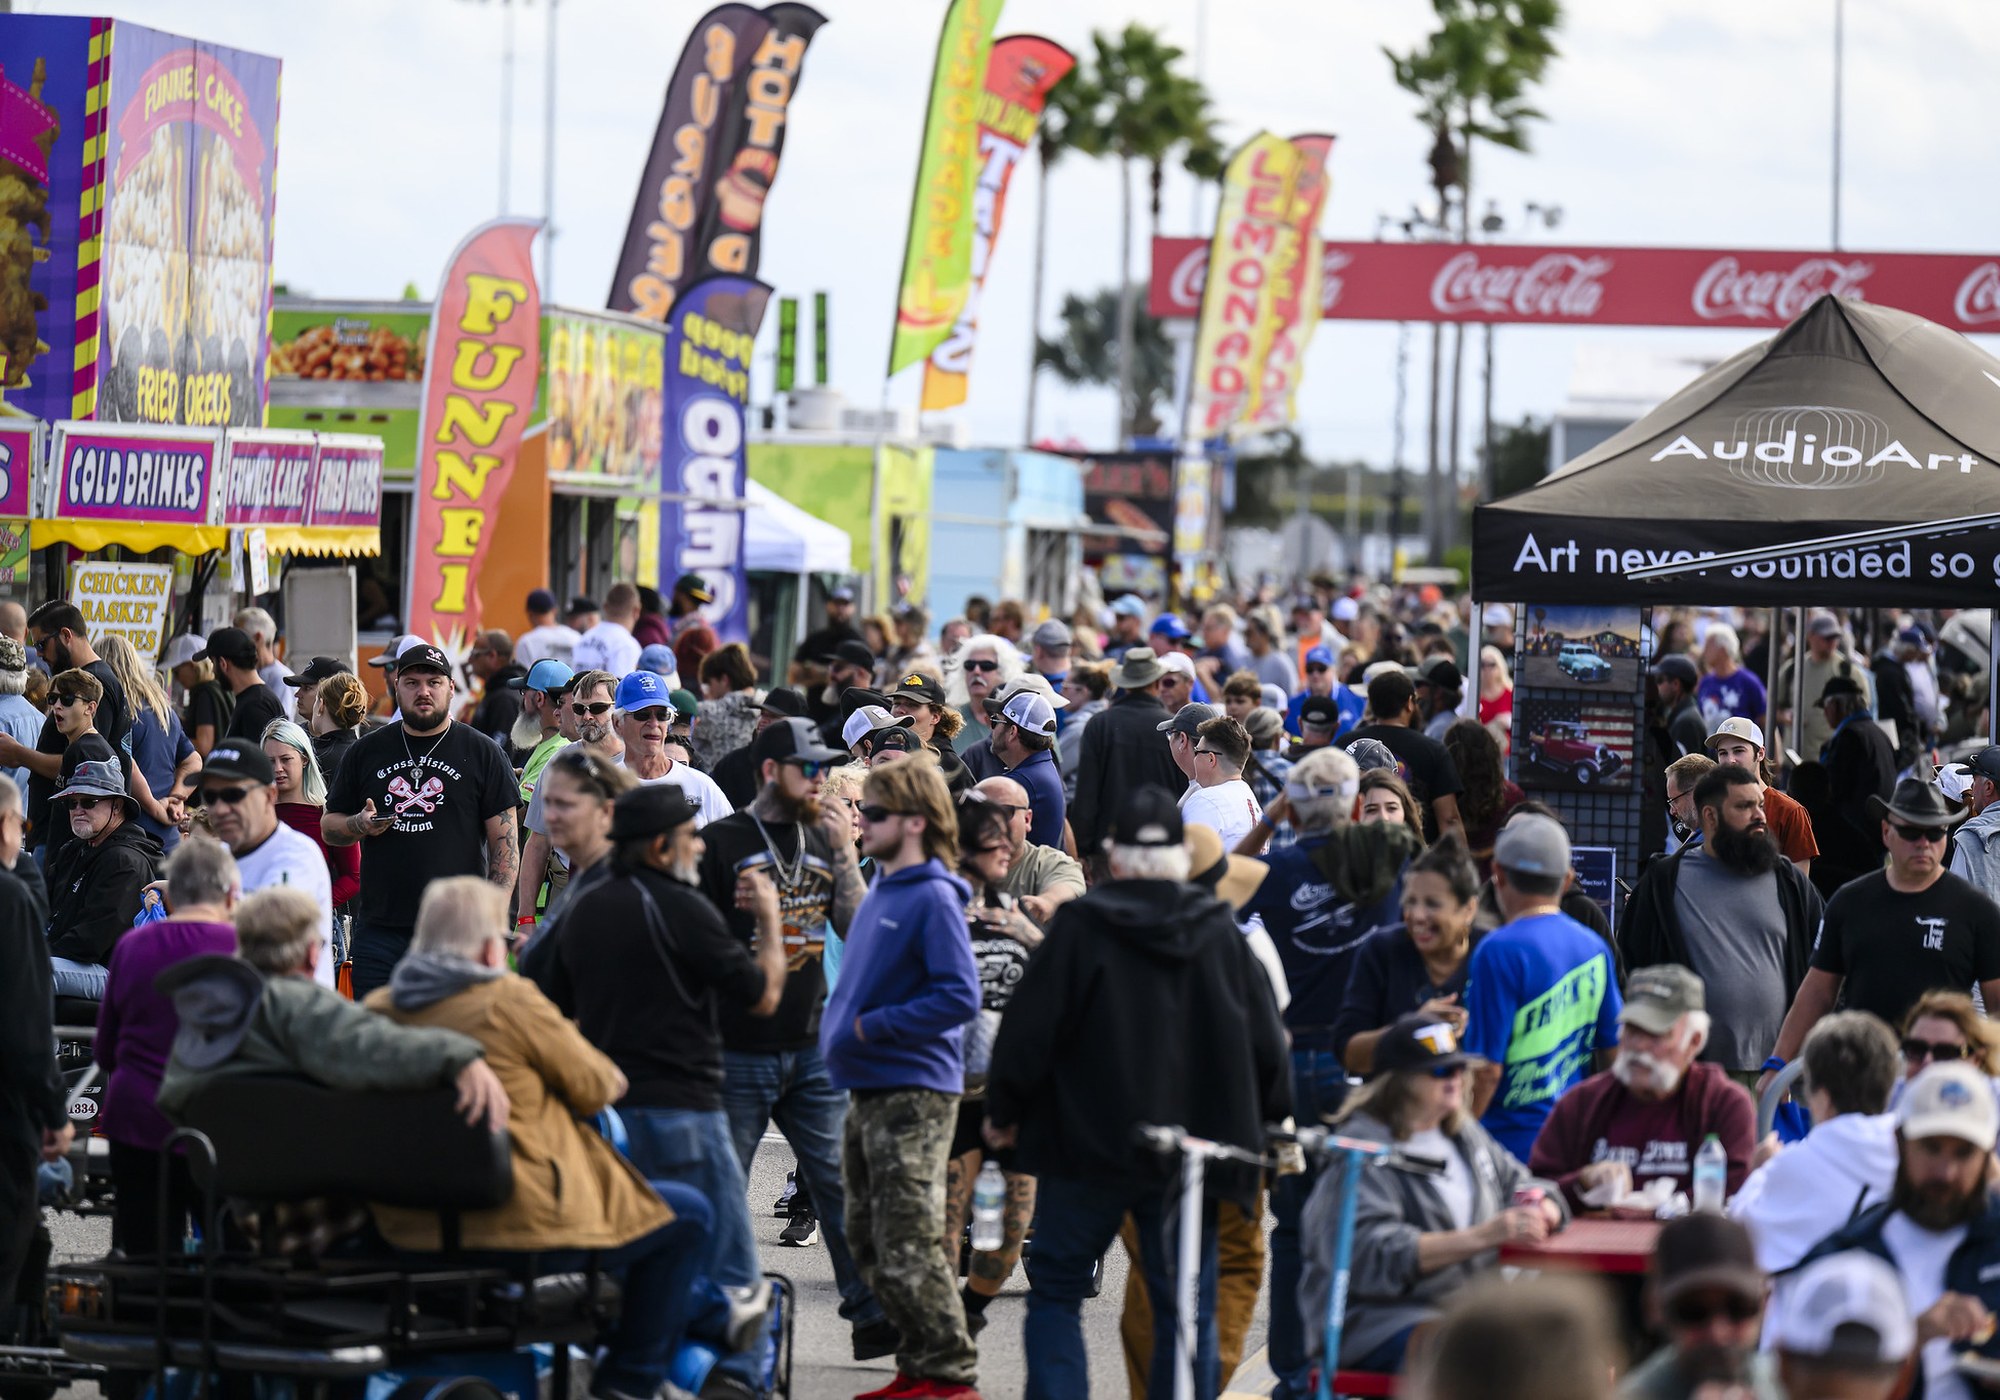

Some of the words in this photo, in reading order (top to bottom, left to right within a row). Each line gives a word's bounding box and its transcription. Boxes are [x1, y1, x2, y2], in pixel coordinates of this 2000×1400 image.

[145, 64, 200, 122] FUNNEL
[205, 73, 243, 138] CAKE
[137, 364, 179, 423] FRIED
[184, 371, 232, 427] OREOS
[1651, 430, 1979, 474] AudioArt
[69, 446, 121, 505] COLD
[122, 451, 204, 511] DRINKS
[228, 456, 276, 506] FUNNEL
[274, 457, 310, 507] CAKE
[1513, 532, 1580, 573] Art
[1930, 552, 1975, 579] so
[79, 572, 167, 595] CHICKEN
[81, 599, 157, 624] BASKET
[104, 629, 157, 652] IES
[377, 759, 414, 779] Cross
[419, 756, 462, 780] Pistons
[384, 794, 393, 806] 9
[435, 794, 445, 805] 2
[392, 819, 434, 833] Saloon
[69, 1103, 96, 1114] 1334
